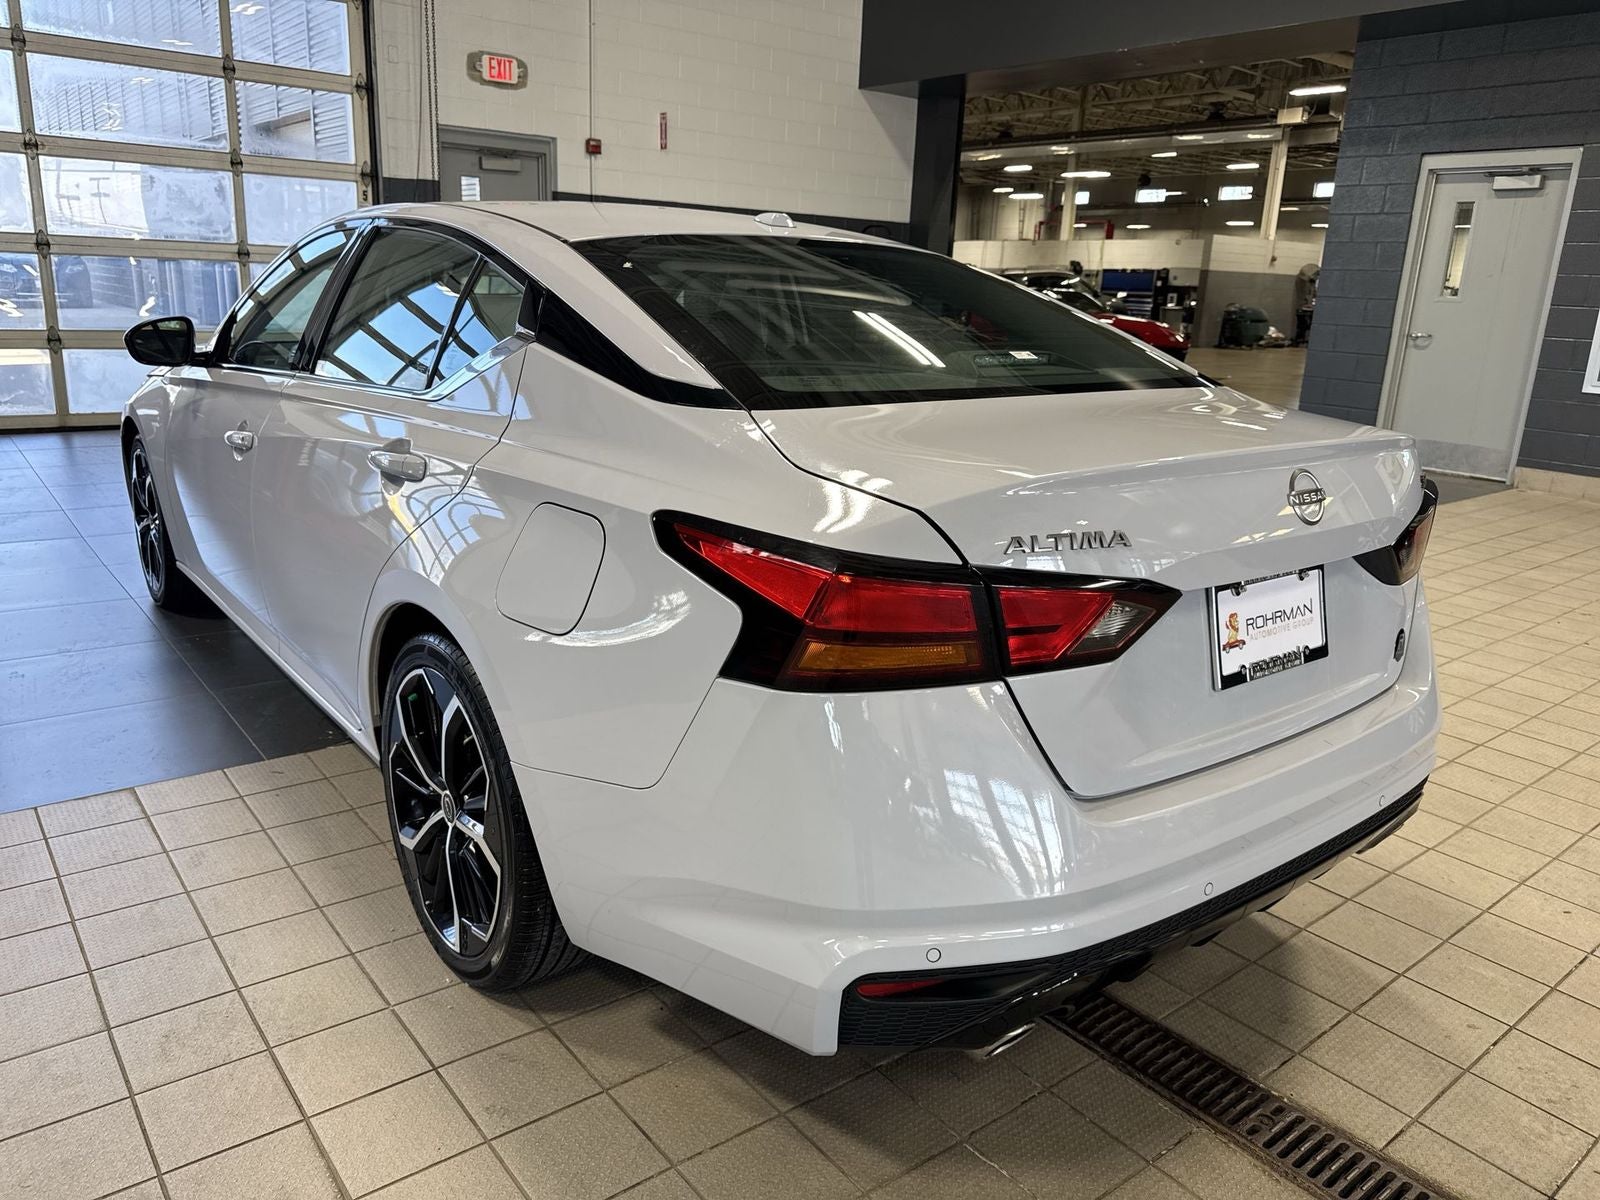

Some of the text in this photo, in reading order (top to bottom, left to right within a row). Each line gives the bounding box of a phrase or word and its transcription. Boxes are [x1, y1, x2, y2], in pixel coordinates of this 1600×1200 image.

[488, 56, 513, 81] EXIT
[362, 190, 368, 201] 5
[1003, 530, 1132, 554] ALTIMA
[1245, 598, 1313, 636] ROHRMAN
[1249, 616, 1314, 641] AUTOMOTIVE GROUP
